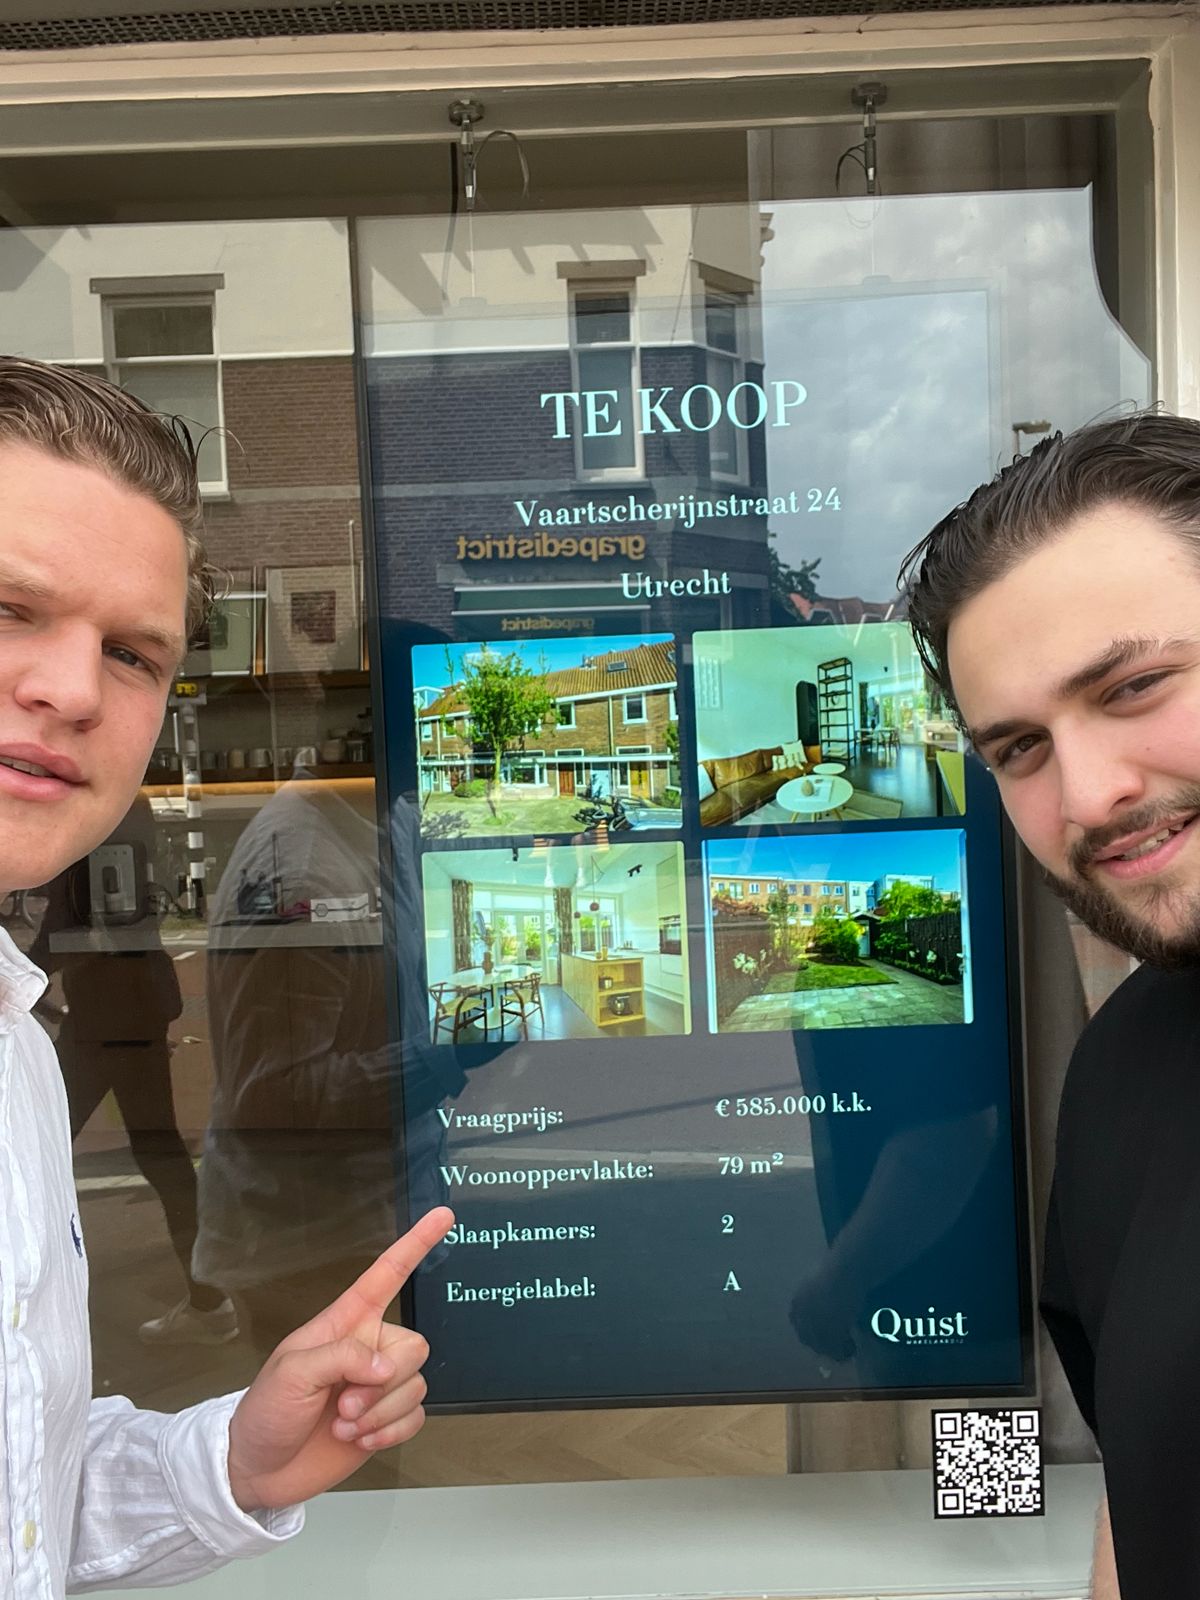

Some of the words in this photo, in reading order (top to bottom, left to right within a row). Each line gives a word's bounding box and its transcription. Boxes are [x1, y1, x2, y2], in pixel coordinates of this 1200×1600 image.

[540, 389, 622, 439] TE
[637, 380, 808, 434] KOOP
[513, 490, 800, 529] Vaartscherijnstraat
[807, 487, 842, 513] 24
[620, 569, 732, 599] Utrecht
[437, 1106, 564, 1134] Vraagprijs:
[714, 1098, 730, 1118] €
[735, 1095, 826, 1117] 585.000
[832, 1091, 872, 1114] k.k.
[440, 1159, 654, 1190] Woonoppervlakte:
[717, 1155, 744, 1176] 79
[750, 1152, 784, 1175] m²
[443, 1221, 596, 1250] Slaapkamers:
[721, 1214, 735, 1234] 2
[446, 1276, 596, 1307] Energielabel:
[723, 1270, 742, 1291] A
[871, 1306, 969, 1343] Quist
